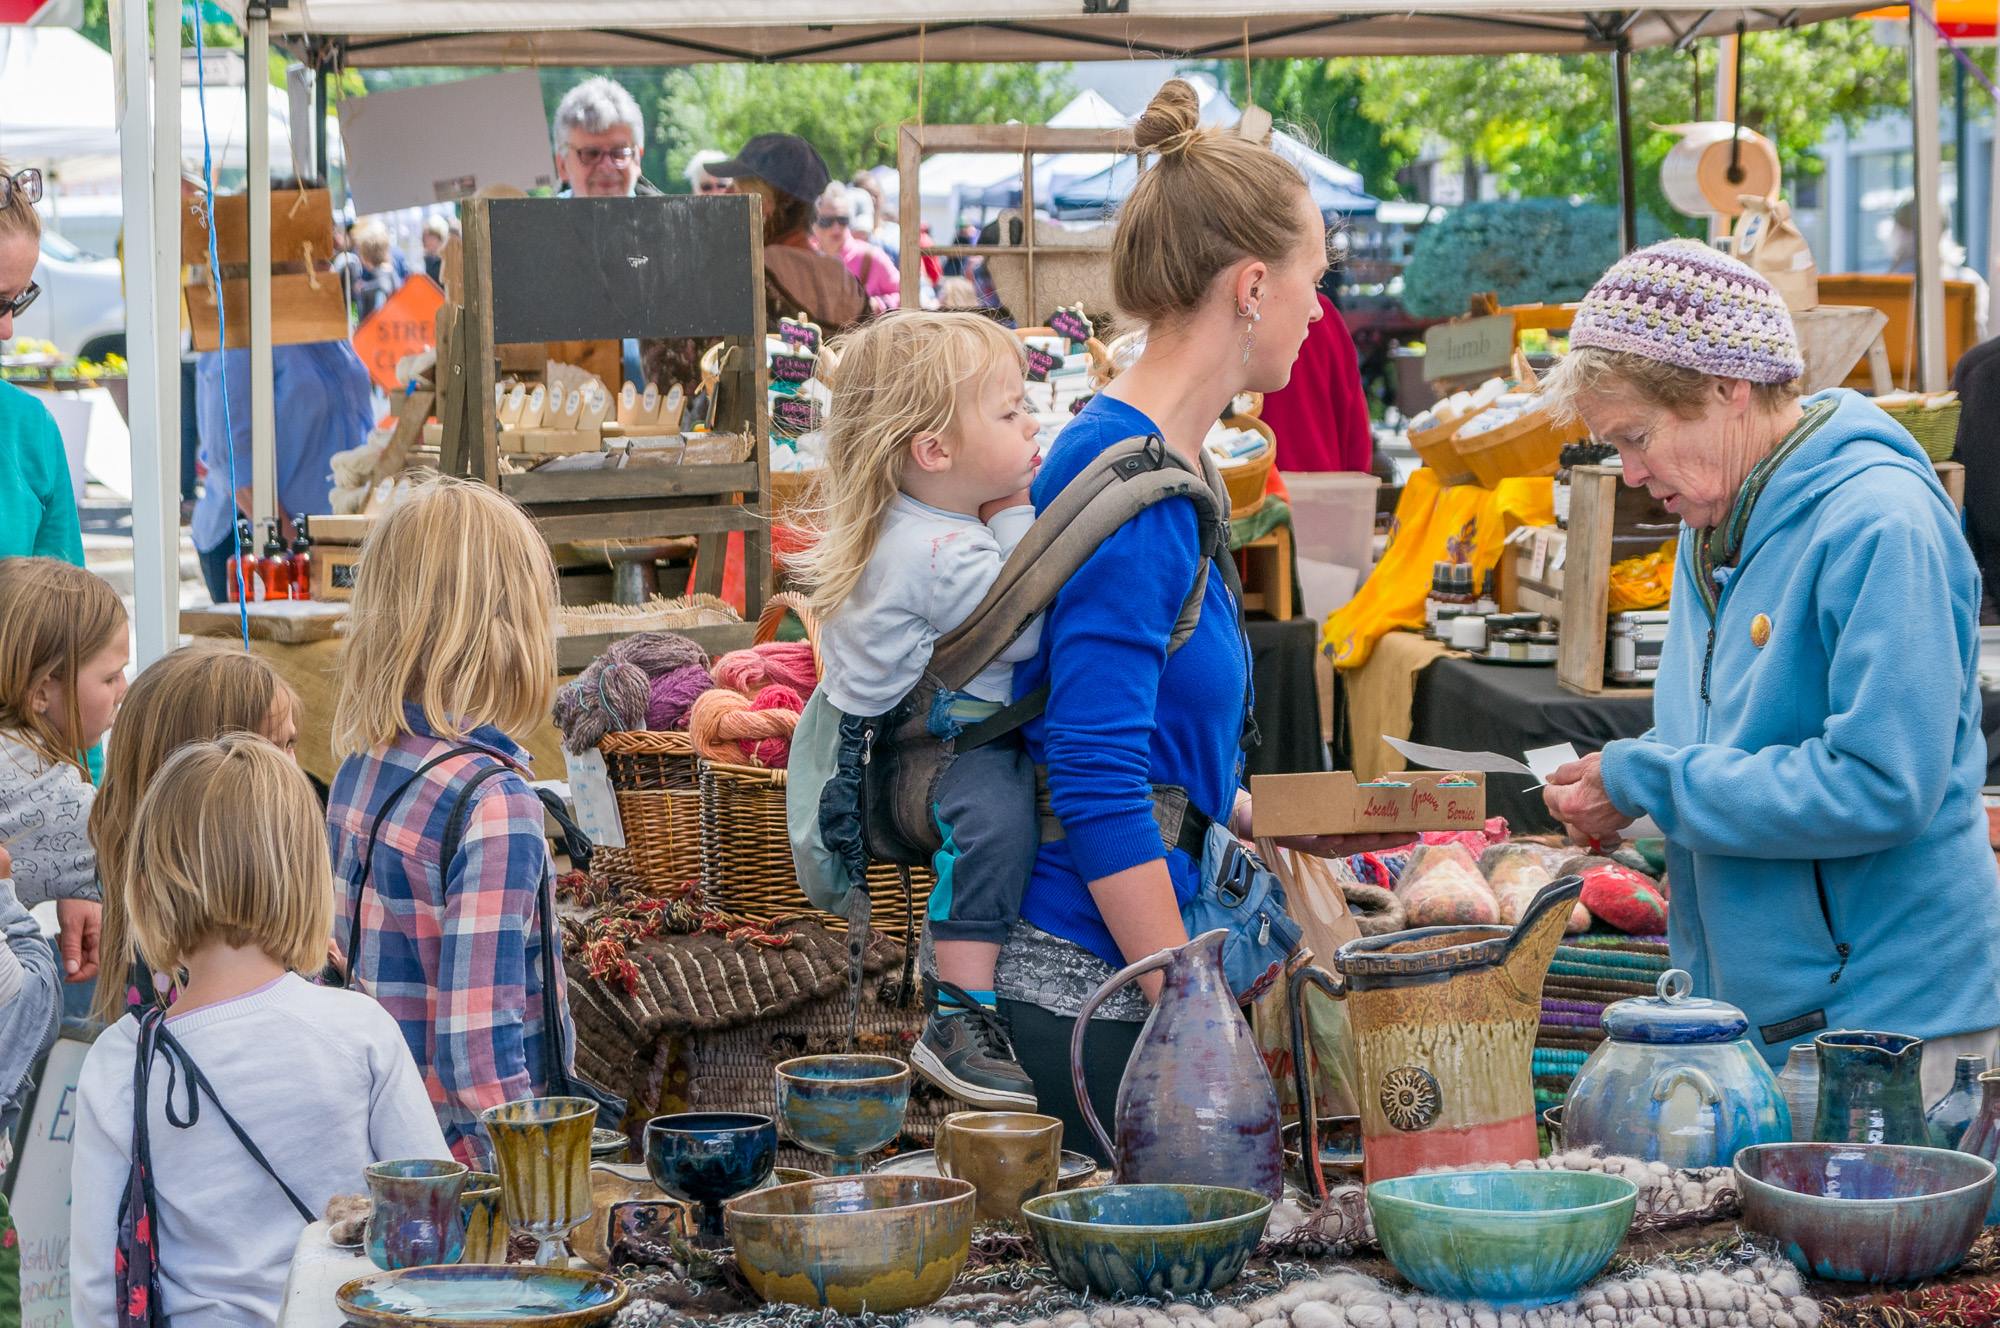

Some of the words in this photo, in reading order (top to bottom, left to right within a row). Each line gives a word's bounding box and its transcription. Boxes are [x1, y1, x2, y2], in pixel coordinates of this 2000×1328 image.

[1364, 797, 1399, 822] Locally
[1411, 787, 1440, 818] Grown
[1447, 800, 1476, 821] Berries
